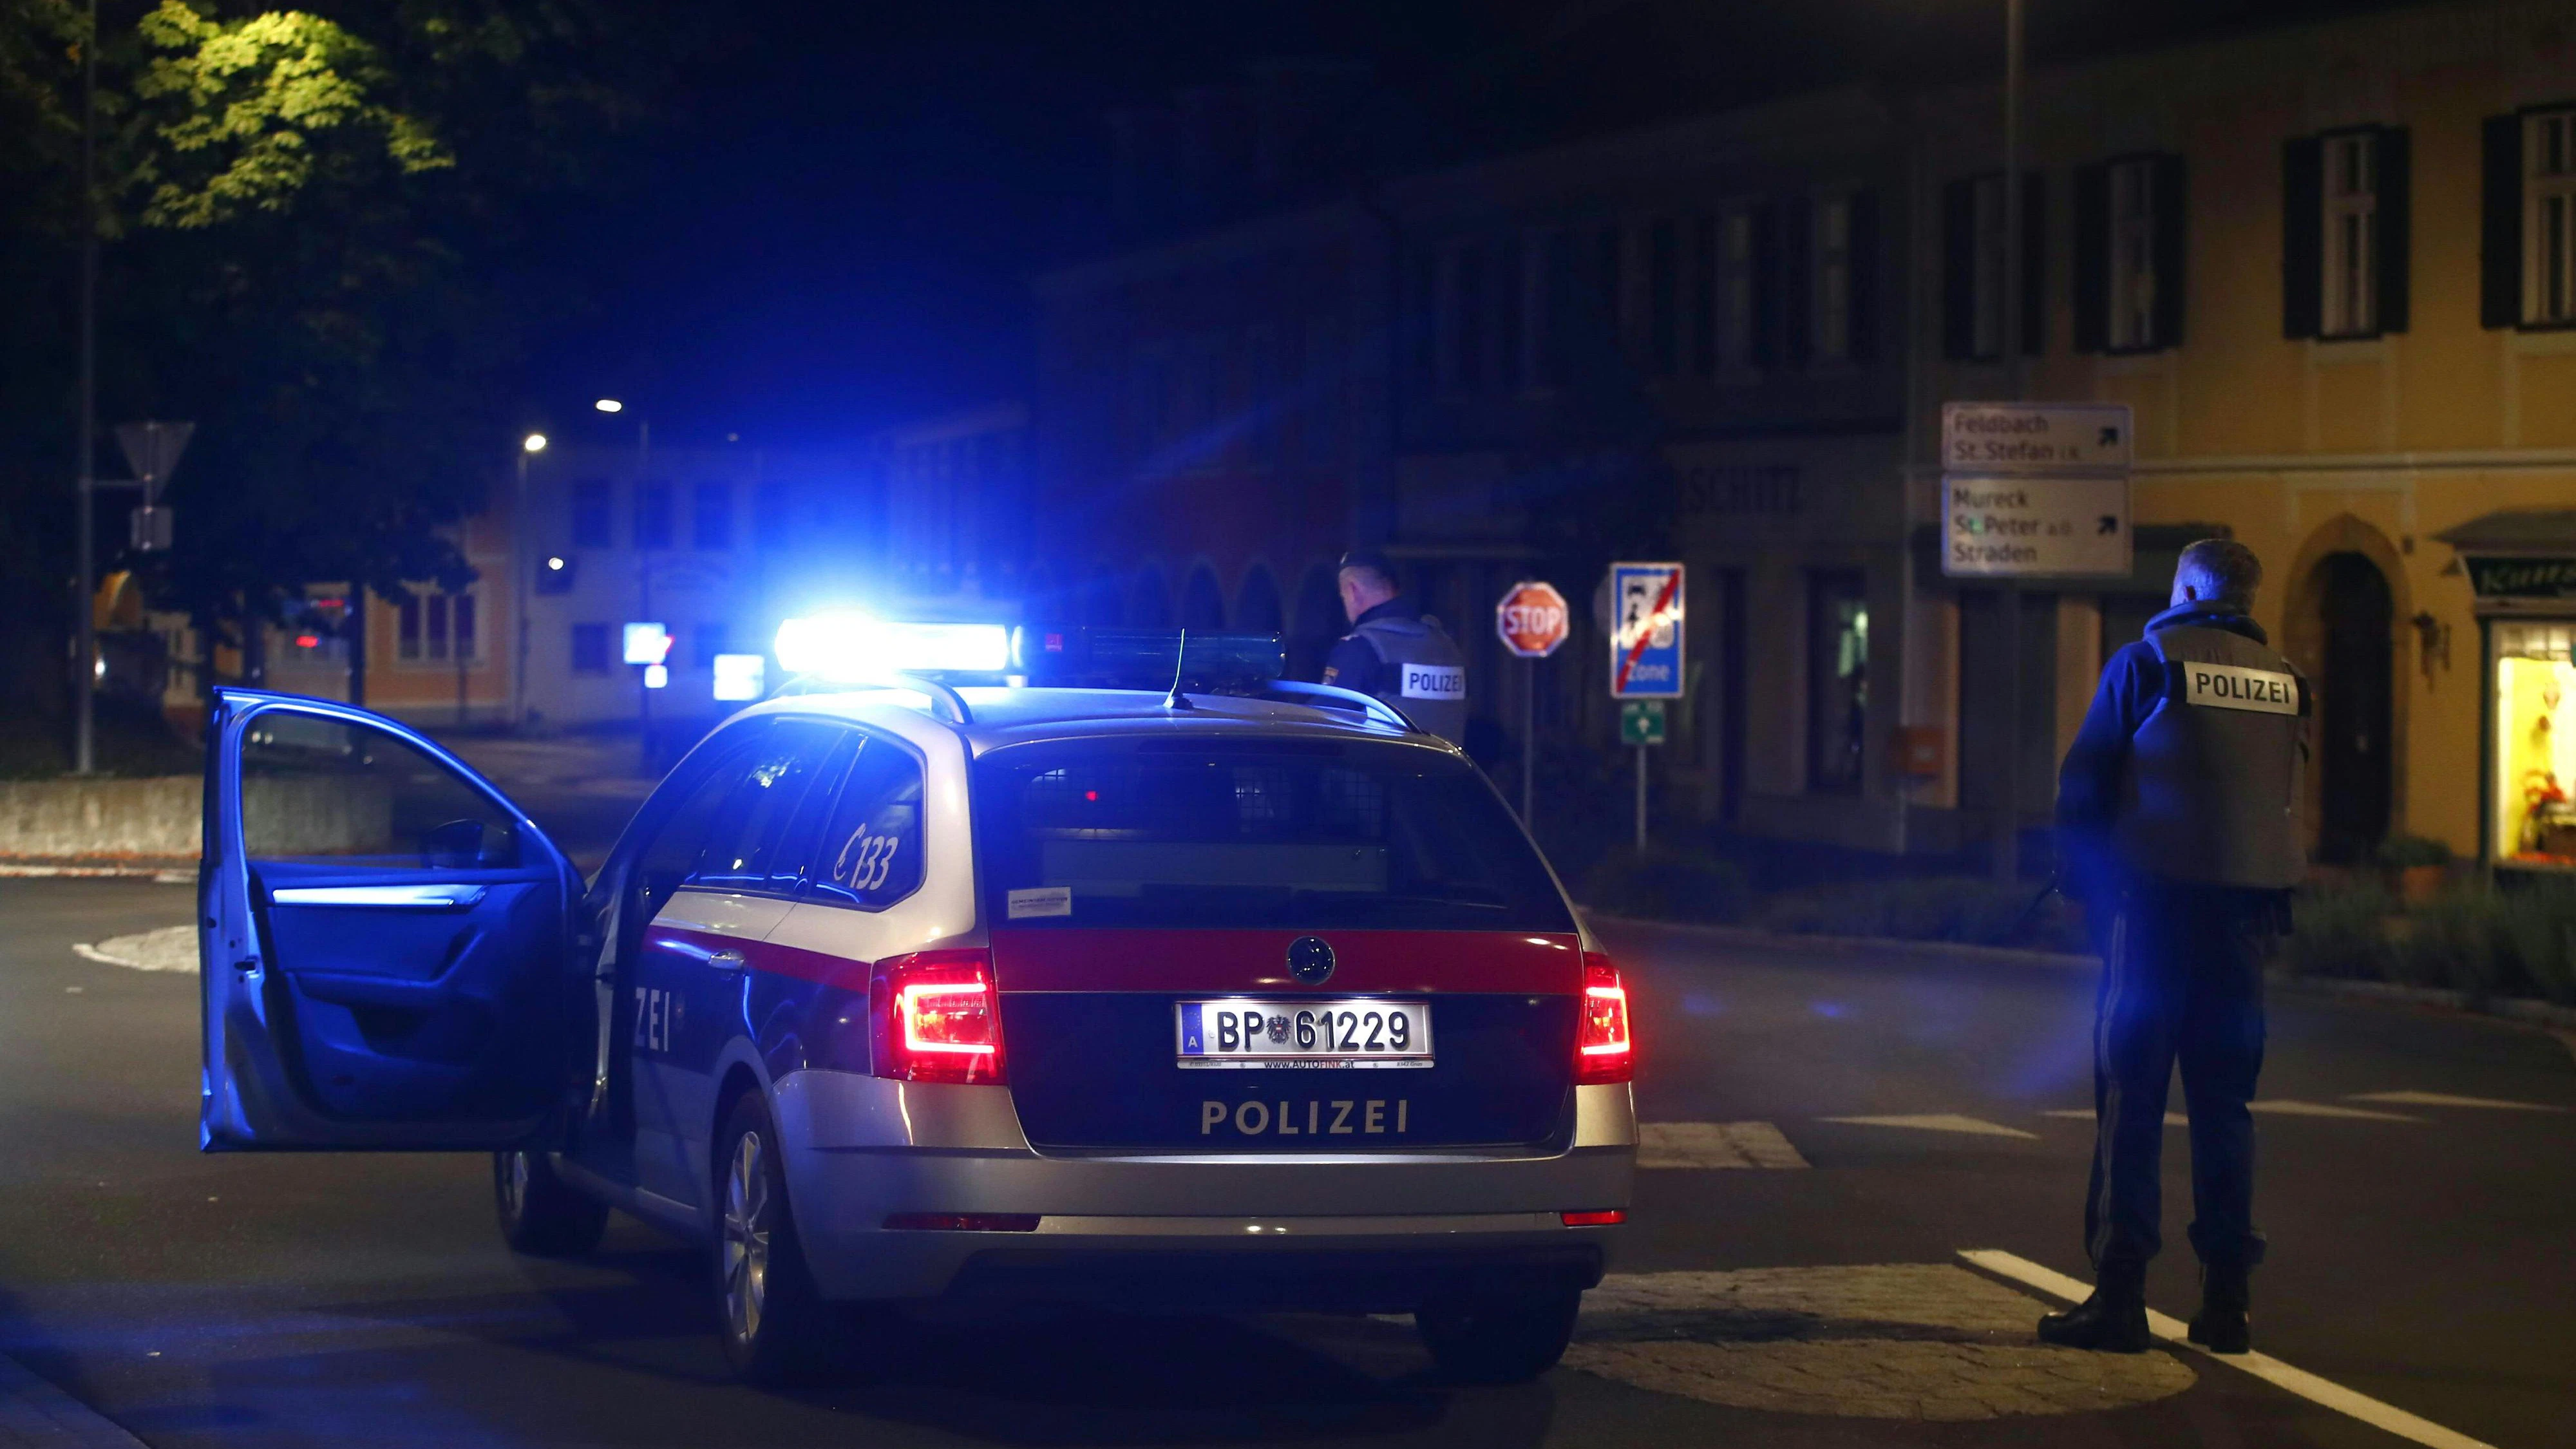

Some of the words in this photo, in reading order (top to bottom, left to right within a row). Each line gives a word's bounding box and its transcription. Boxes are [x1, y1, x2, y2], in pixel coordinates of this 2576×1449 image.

[1954, 413, 2049, 434] Feldbach
[1984, 440, 2054, 460] Stefan
[1953, 488, 2029, 509] Mureck
[1984, 515, 2039, 536] Peter
[1954, 543, 2038, 563] Straden
[1506, 605, 1561, 634] STOP
[1408, 672, 1463, 692] POLIZEI
[1627, 663, 1671, 681] Zone
[2195, 672, 2290, 704] POLIZEI
[849, 836, 899, 890] 133
[1217, 1010, 1265, 1052] BP
[1294, 1010, 1410, 1051] 61229
[1188, 1037, 1198, 1048] A
[1264, 1060, 1355, 1069] www.AUTOFINK.at
[1201, 1099, 1408, 1135] POLIZEI
